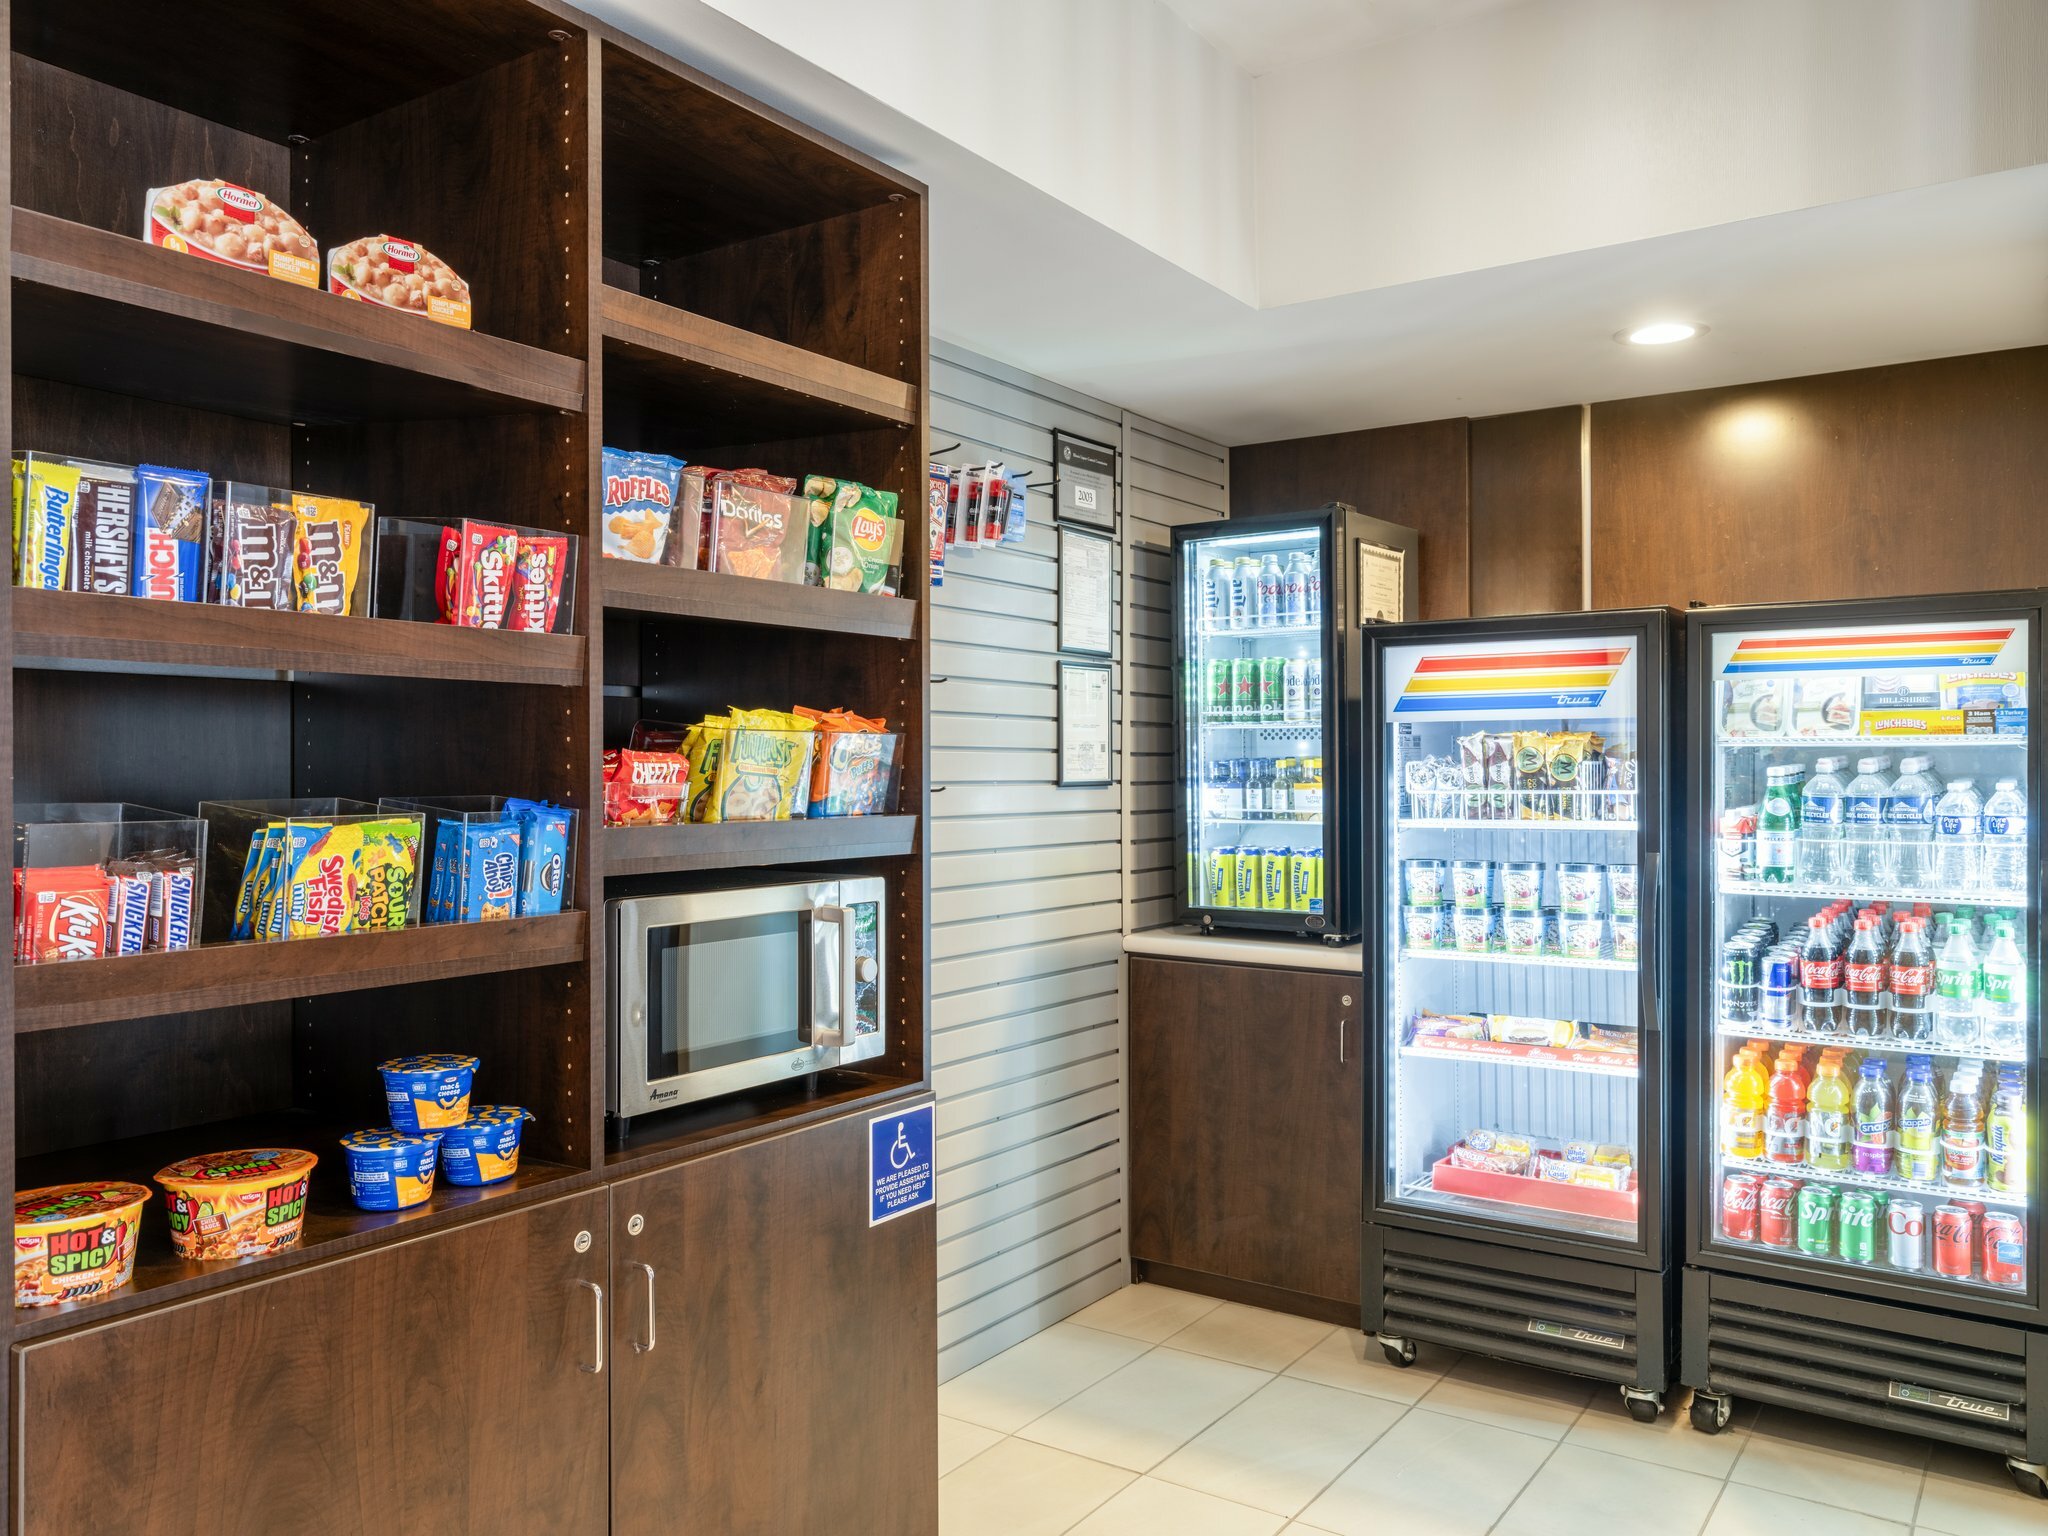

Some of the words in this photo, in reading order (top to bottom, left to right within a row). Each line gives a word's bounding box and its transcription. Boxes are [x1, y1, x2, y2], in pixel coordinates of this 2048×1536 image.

[223, 190, 257, 208] Hormel
[273, 252, 310, 270] DUMPLINGS
[387, 245, 416, 259] Hormel
[273, 260, 301, 274] CHICKEN
[606, 476, 670, 507] RUFFLES
[1078, 490, 1093, 503] 2003
[720, 498, 783, 529] Doritos
[94, 486, 131, 595] HERSHEY'S
[1958, 656, 1988, 665] true
[1552, 694, 1595, 705] true
[1879, 696, 1931, 704] HILLSHIRE
[1875, 718, 1928, 730] LUNCHABLES
[495, 853, 513, 890] Chips
[552, 853, 561, 897] OREO
[369, 866, 390, 927] PATCH
[386, 866, 406, 927] SOUR
[1266, 873, 1275, 902] TWISTED
[1294, 874, 1302, 903] TWISTED
[291, 883, 305, 921] mini
[305, 876, 327, 925] Fish
[361, 895, 371, 920] Kids
[121, 881, 149, 955] SNICKER
[1936, 970, 1975, 985] Sprite
[650, 1089, 679, 1100] Amana
[1992, 1125, 2004, 1165] Nsquik
[875, 1182, 899, 1196] PROVIDE
[898, 1171, 930, 1188] ASSISTANCE
[876, 1176, 885, 1187] WE
[885, 1173, 898, 1184] ARE
[897, 1165, 921, 1180] PLEASED
[922, 1162, 930, 1171] TO
[241, 1193, 262, 1201] NISSIN
[268, 1182, 302, 1209] HOT
[879, 1194, 885, 1203] IF
[885, 1191, 897, 1201] YOU
[897, 1186, 912, 1198] NEED
[912, 1181, 926, 1192] HELP
[887, 1196, 908, 1209] PLEASE
[908, 1191, 919, 1201] ASK
[177, 1200, 188, 1213] &
[51, 1227, 104, 1256] HOT
[101, 1229, 116, 1244] &
[267, 1223, 295, 1235] CHICKEN
[50, 1244, 116, 1275] SPICY
[51, 1271, 96, 1285] CHICKEN
